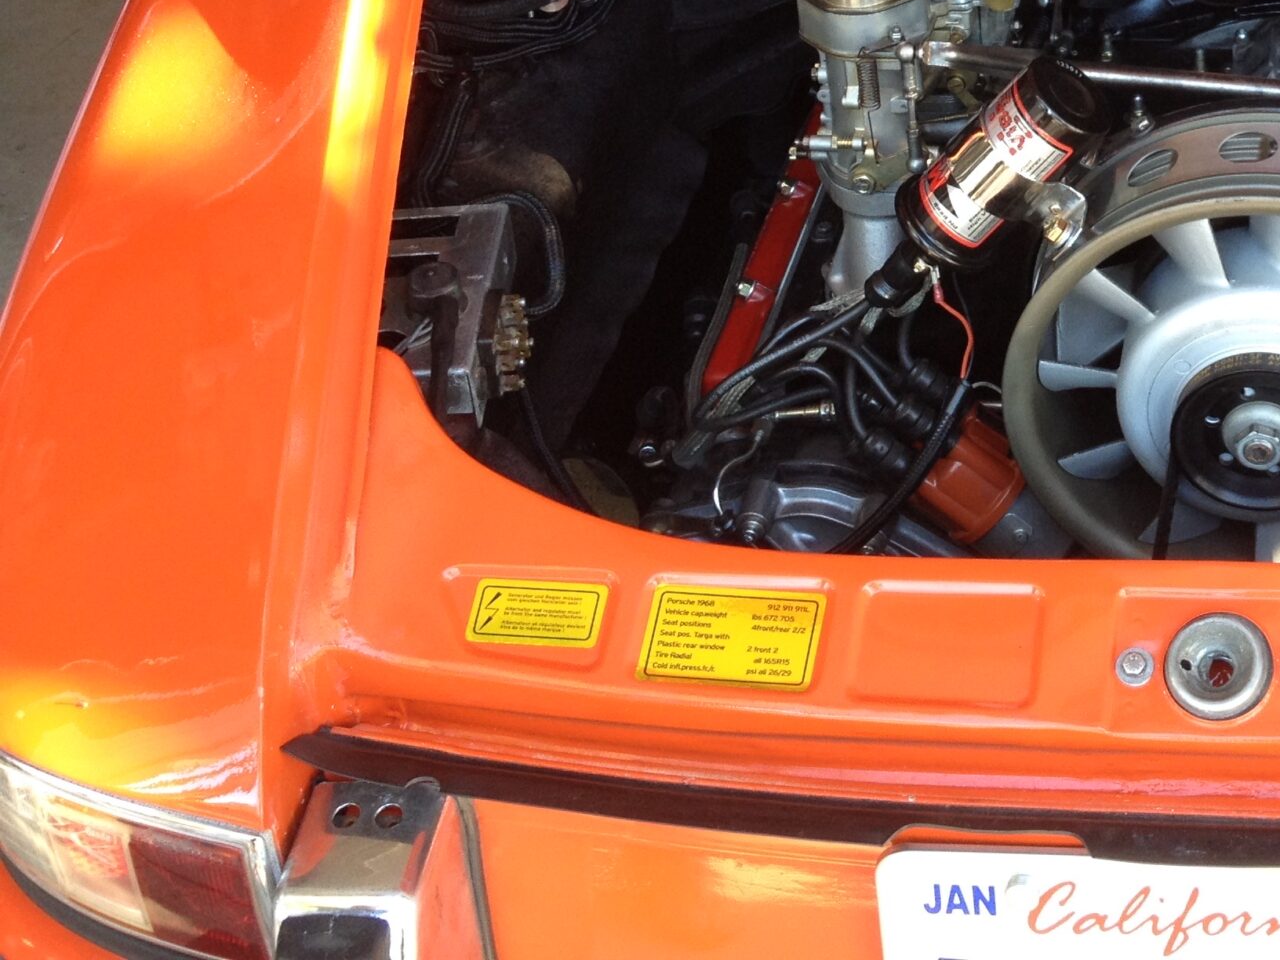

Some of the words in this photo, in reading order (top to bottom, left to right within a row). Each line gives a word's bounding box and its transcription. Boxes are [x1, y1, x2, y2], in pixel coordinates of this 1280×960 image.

[667, 597, 695, 606] Porsche
[767, 603, 781, 611] 912
[665, 607, 690, 616] Vehicle
[662, 618, 678, 626] Seat
[763, 614, 778, 622] 672
[660, 629, 676, 637] Seat
[694, 631, 713, 640] Targa
[657, 640, 681, 648] Plastic
[754, 646, 771, 654] front
[670, 652, 692, 660] Radial
[923, 883, 997, 916] JAN
